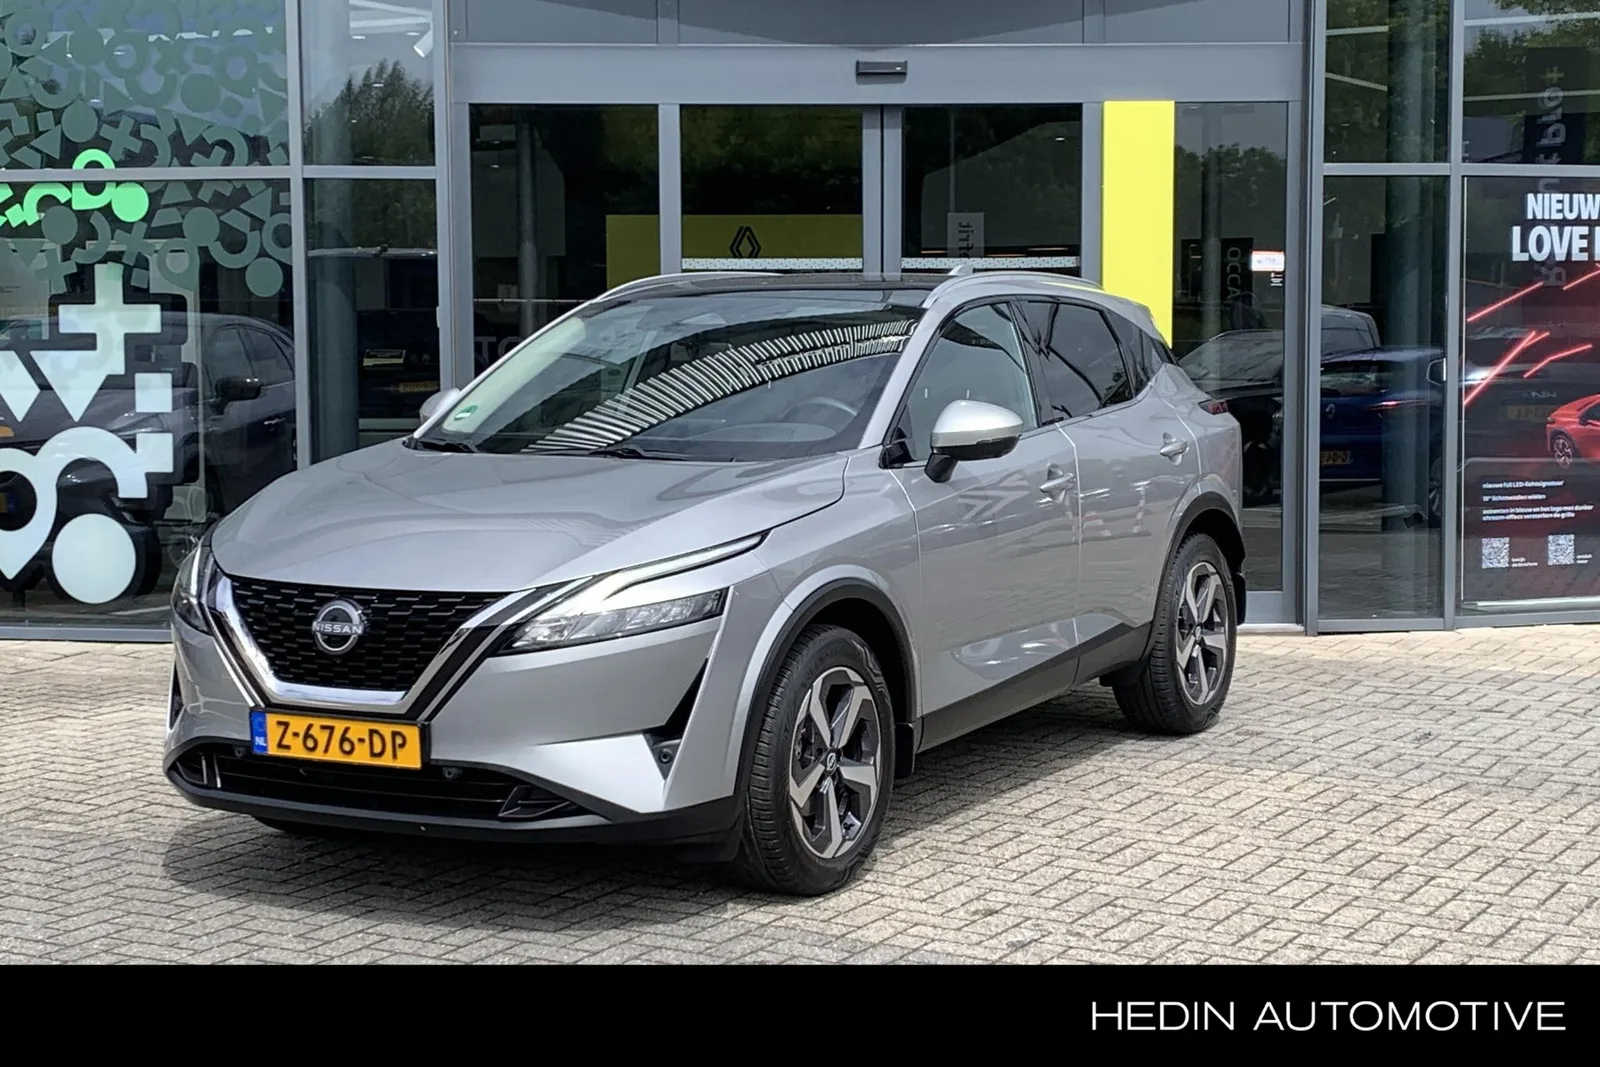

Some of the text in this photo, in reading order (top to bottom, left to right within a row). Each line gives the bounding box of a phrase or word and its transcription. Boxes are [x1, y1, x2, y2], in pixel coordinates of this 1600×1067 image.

[1527, 193, 1600, 220] NIEUW
[1512, 225, 1589, 262] LOVE
[312, 620, 363, 635] NISSAN
[255, 735, 267, 747] NL
[275, 720, 408, 760] Z-676-DP
